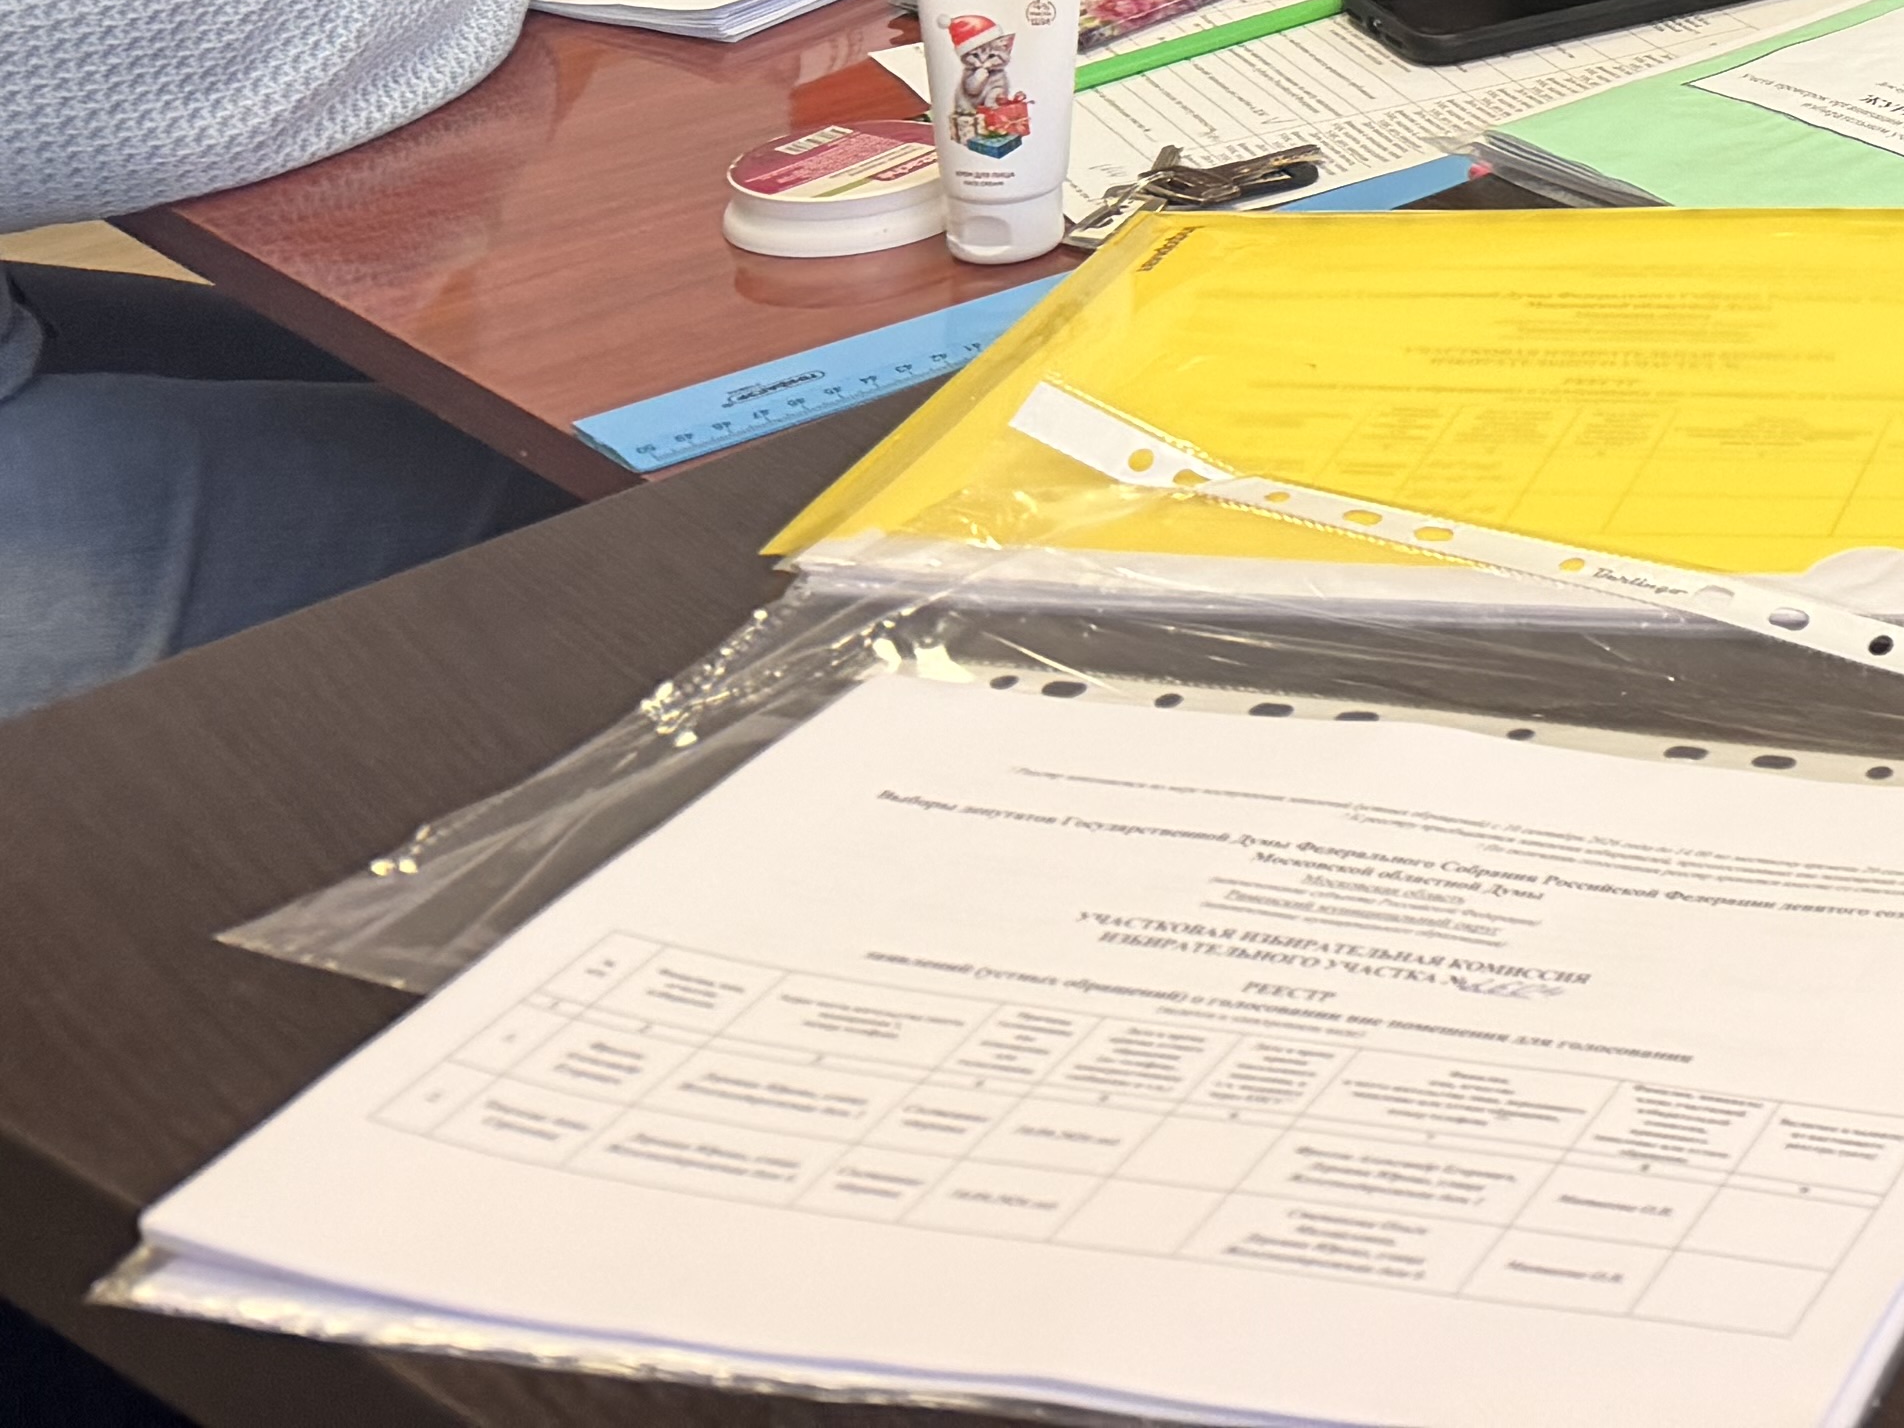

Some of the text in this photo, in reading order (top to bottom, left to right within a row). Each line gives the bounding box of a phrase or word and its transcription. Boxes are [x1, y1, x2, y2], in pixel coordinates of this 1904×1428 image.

[959, 803, 1057, 827] депутатов
[1061, 815, 1231, 844] Государственной
[1232, 832, 1291, 852] Думы
[1296, 840, 1435, 871] Федерального
[1439, 857, 1539, 885] Собрания
[1543, 874, 1660, 901] Российской
[1664, 889, 1777, 913] Федерации
[1780, 899, 1870, 919] девятого
[1251, 850, 1546, 904] Московской областной Думы
[1077, 910, 1592, 986] УЧАСТКОВАЯ ИЗБИРАТЕЛЬНАЯ КОМИССИЯ
[1098, 931, 1321, 970] ИЗБИРАТЕЛЬНОГО
[1324, 956, 1440, 986] УЧАСТКА
[1243, 979, 1339, 1004] РЕЕСТР
[1208, 996, 1344, 1026] голосовании
[1387, 1018, 1513, 1045] помещения
[1555, 1037, 1695, 1065] голосования
